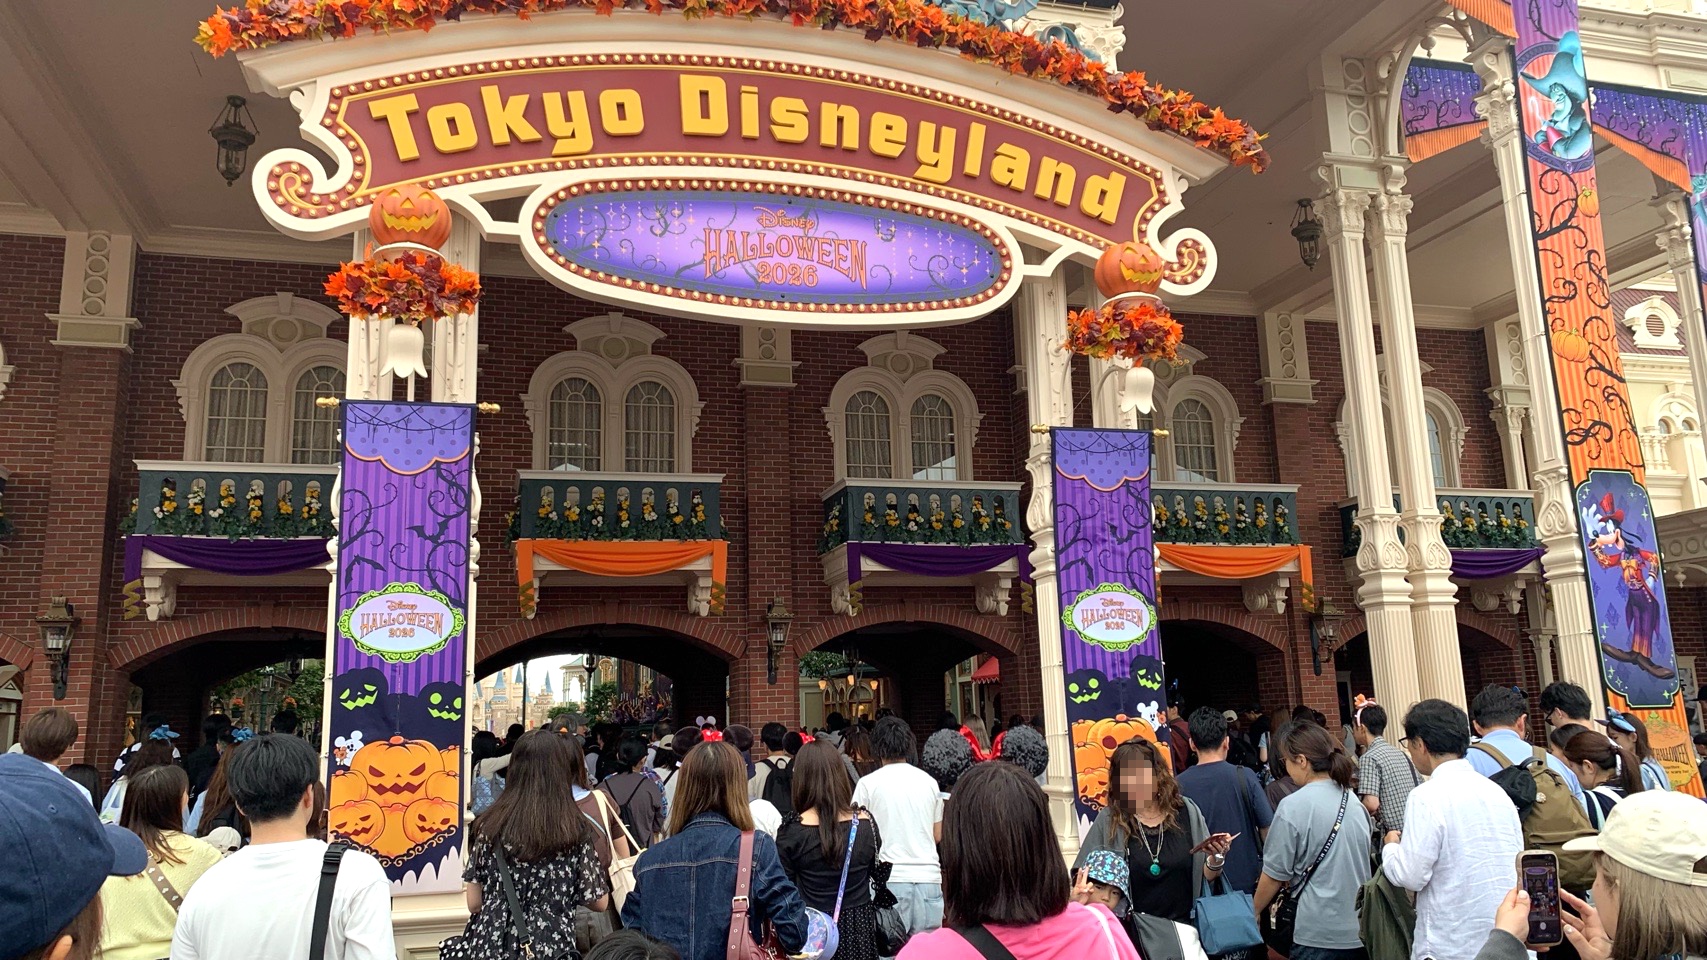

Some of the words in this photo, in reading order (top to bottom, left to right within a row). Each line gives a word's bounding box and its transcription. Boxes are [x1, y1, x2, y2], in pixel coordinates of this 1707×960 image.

[368, 84, 645, 162] Tokyo
[679, 74, 1127, 225] Disneyland
[753, 205, 816, 235] Disney
[703, 228, 868, 290] HALLOWEEN
[756, 261, 819, 288] 2026
[385, 600, 418, 613] Disney
[1100, 598, 1125, 608] Disney
[359, 612, 444, 639] HALLOWEEN
[388, 627, 415, 638] 2026
[1081, 608, 1143, 631] HALLOWEEN
